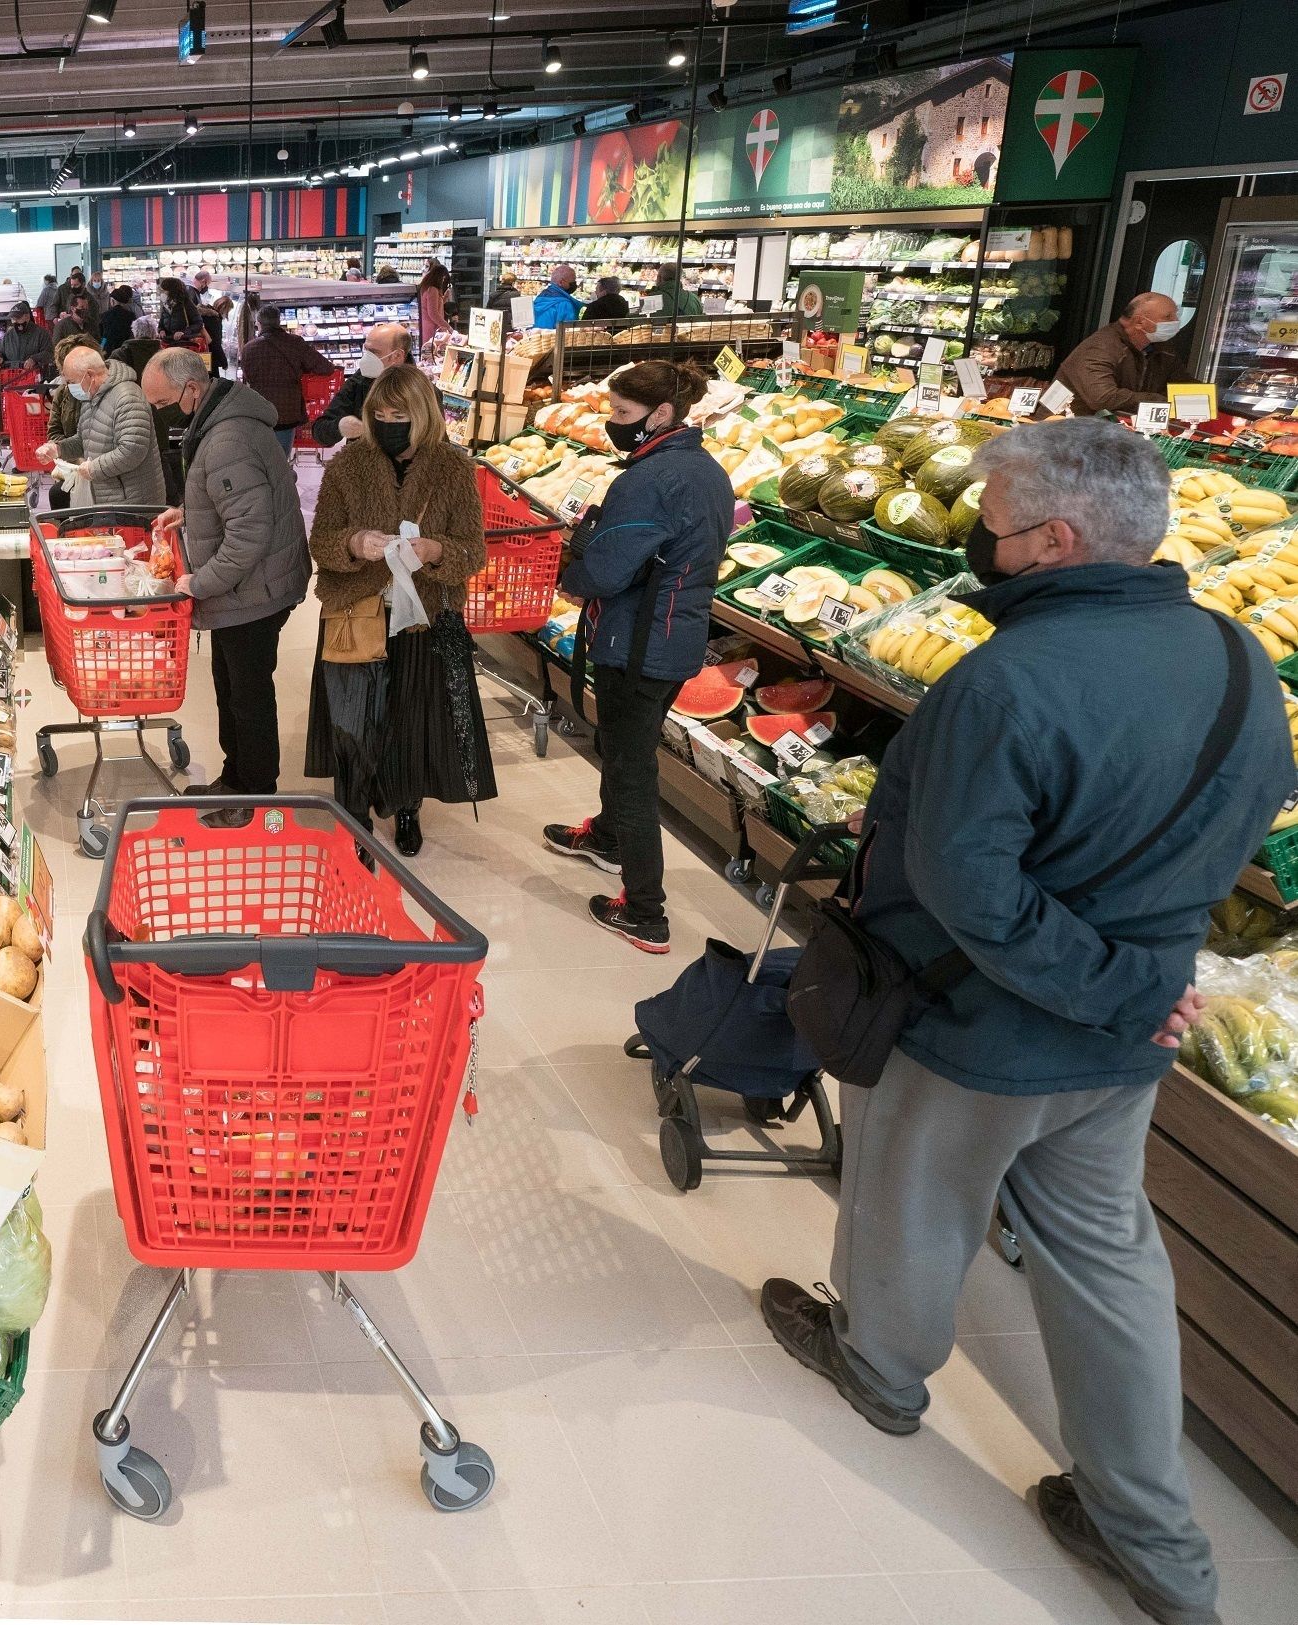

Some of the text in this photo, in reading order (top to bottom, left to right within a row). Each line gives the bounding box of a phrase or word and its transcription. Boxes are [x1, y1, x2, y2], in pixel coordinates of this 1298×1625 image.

[766, 203, 782, 211] bueno
[782, 203, 793, 211] que
[803, 201, 811, 209] de
[811, 199, 826, 210] aquí
[787, 741, 812, 756] 2,59
